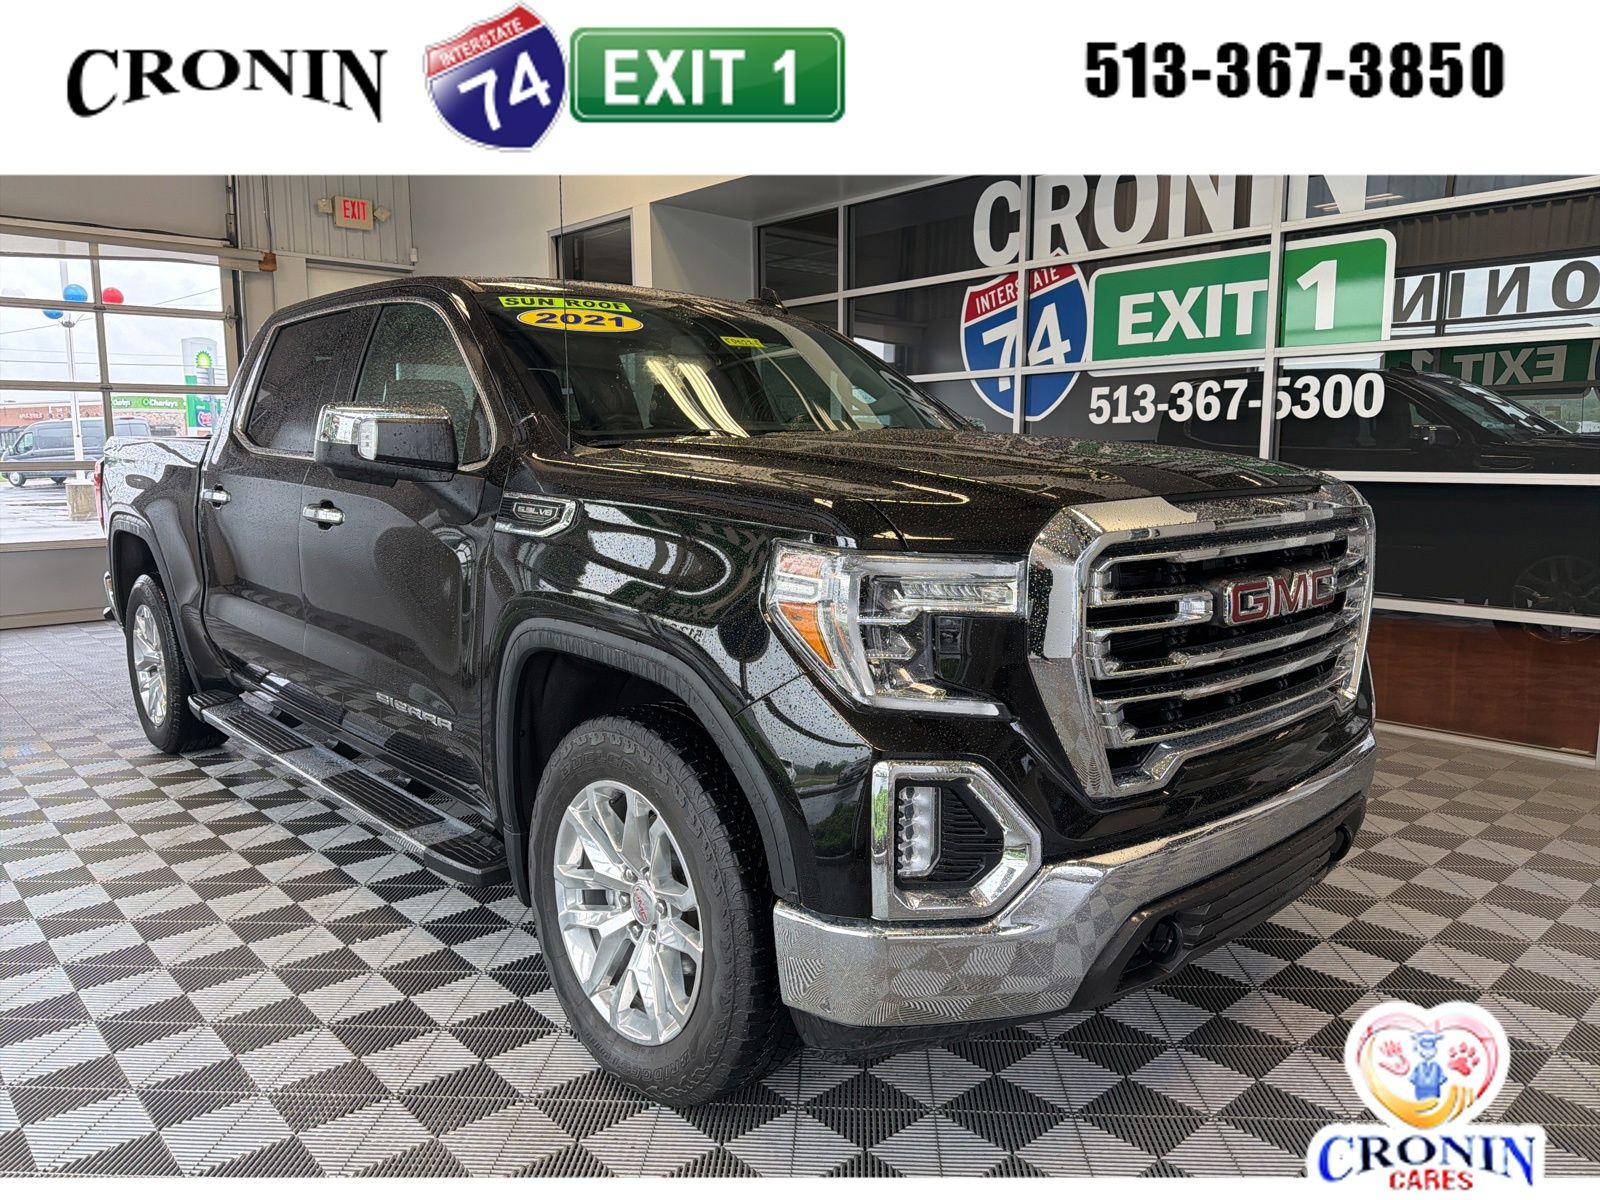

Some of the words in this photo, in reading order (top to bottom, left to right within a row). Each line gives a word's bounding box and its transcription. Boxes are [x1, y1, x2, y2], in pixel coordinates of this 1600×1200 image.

[342, 199, 368, 221] EXIT
[505, 297, 554, 306] SUN
[565, 299, 625, 310] ROOF
[976, 268, 1060, 315] INTERATE
[1118, 279, 1268, 346] EXIT
[1296, 259, 1338, 332] 1
[535, 312, 625, 328] 2021
[982, 303, 1071, 393] 74
[1088, 372, 1386, 425] 513-367-5300
[1225, 566, 1336, 625] GMC
[376, 692, 453, 731] SIERRA
